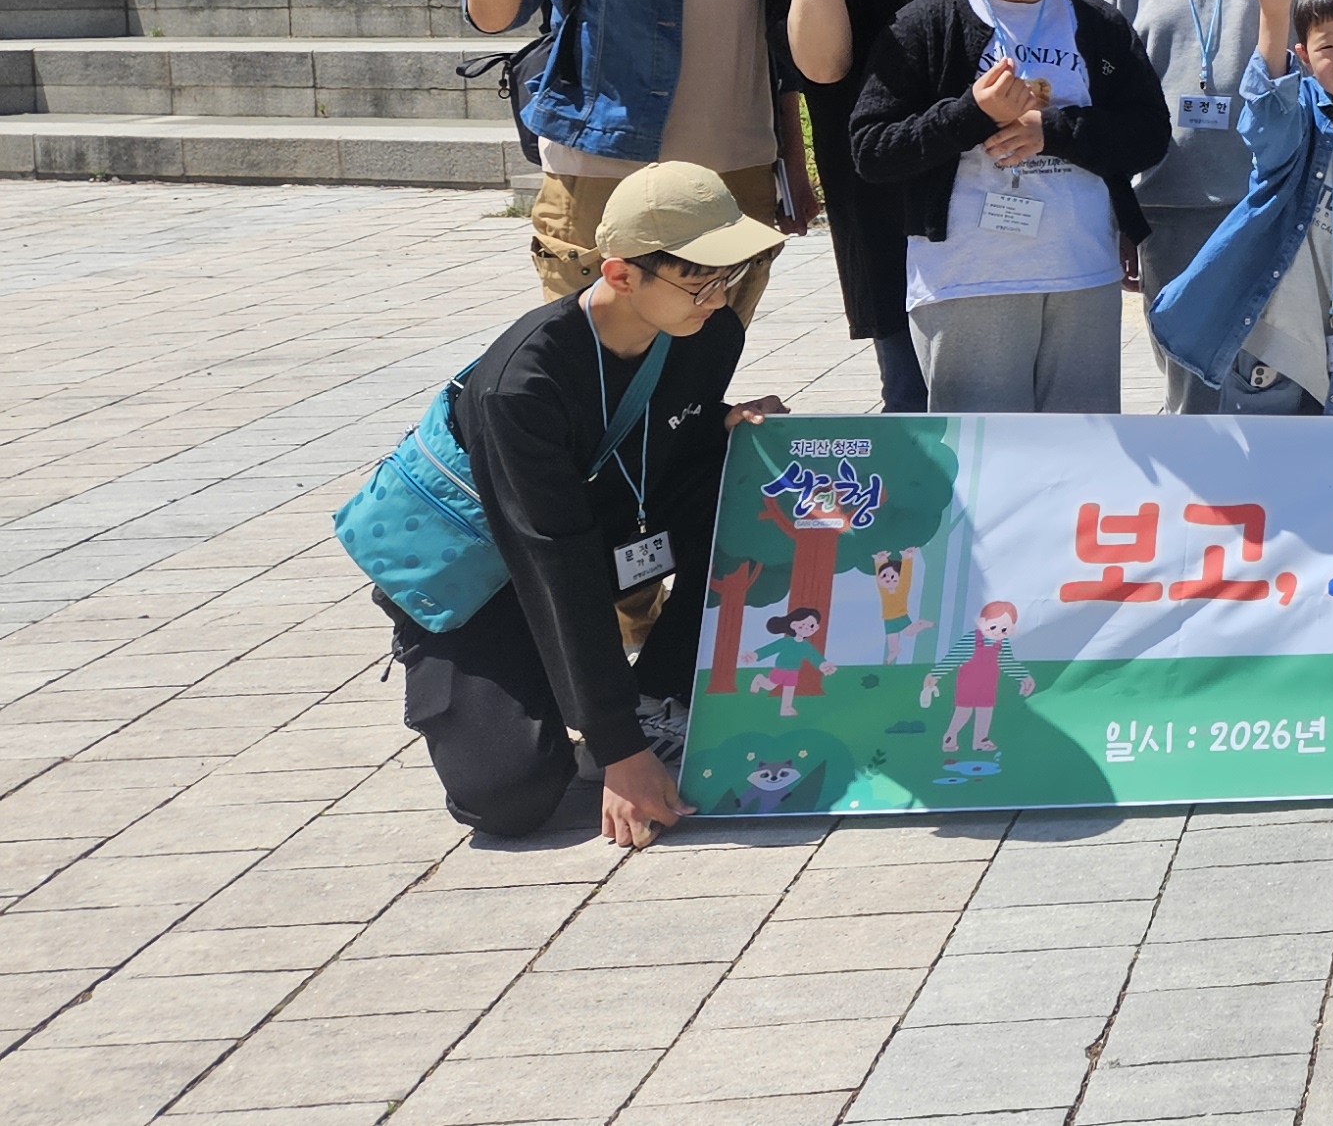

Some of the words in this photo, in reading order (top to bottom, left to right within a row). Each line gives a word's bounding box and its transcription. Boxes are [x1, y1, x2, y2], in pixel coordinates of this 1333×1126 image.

[1015, 44, 1069, 66] ONLY
[792, 440, 829, 456] 지리산
[833, 440, 870, 456] 청정골
[1059, 501, 1297, 606] 보고,
[1105, 720, 1173, 763] 일시
[1208, 715, 1326, 754] 2026년
